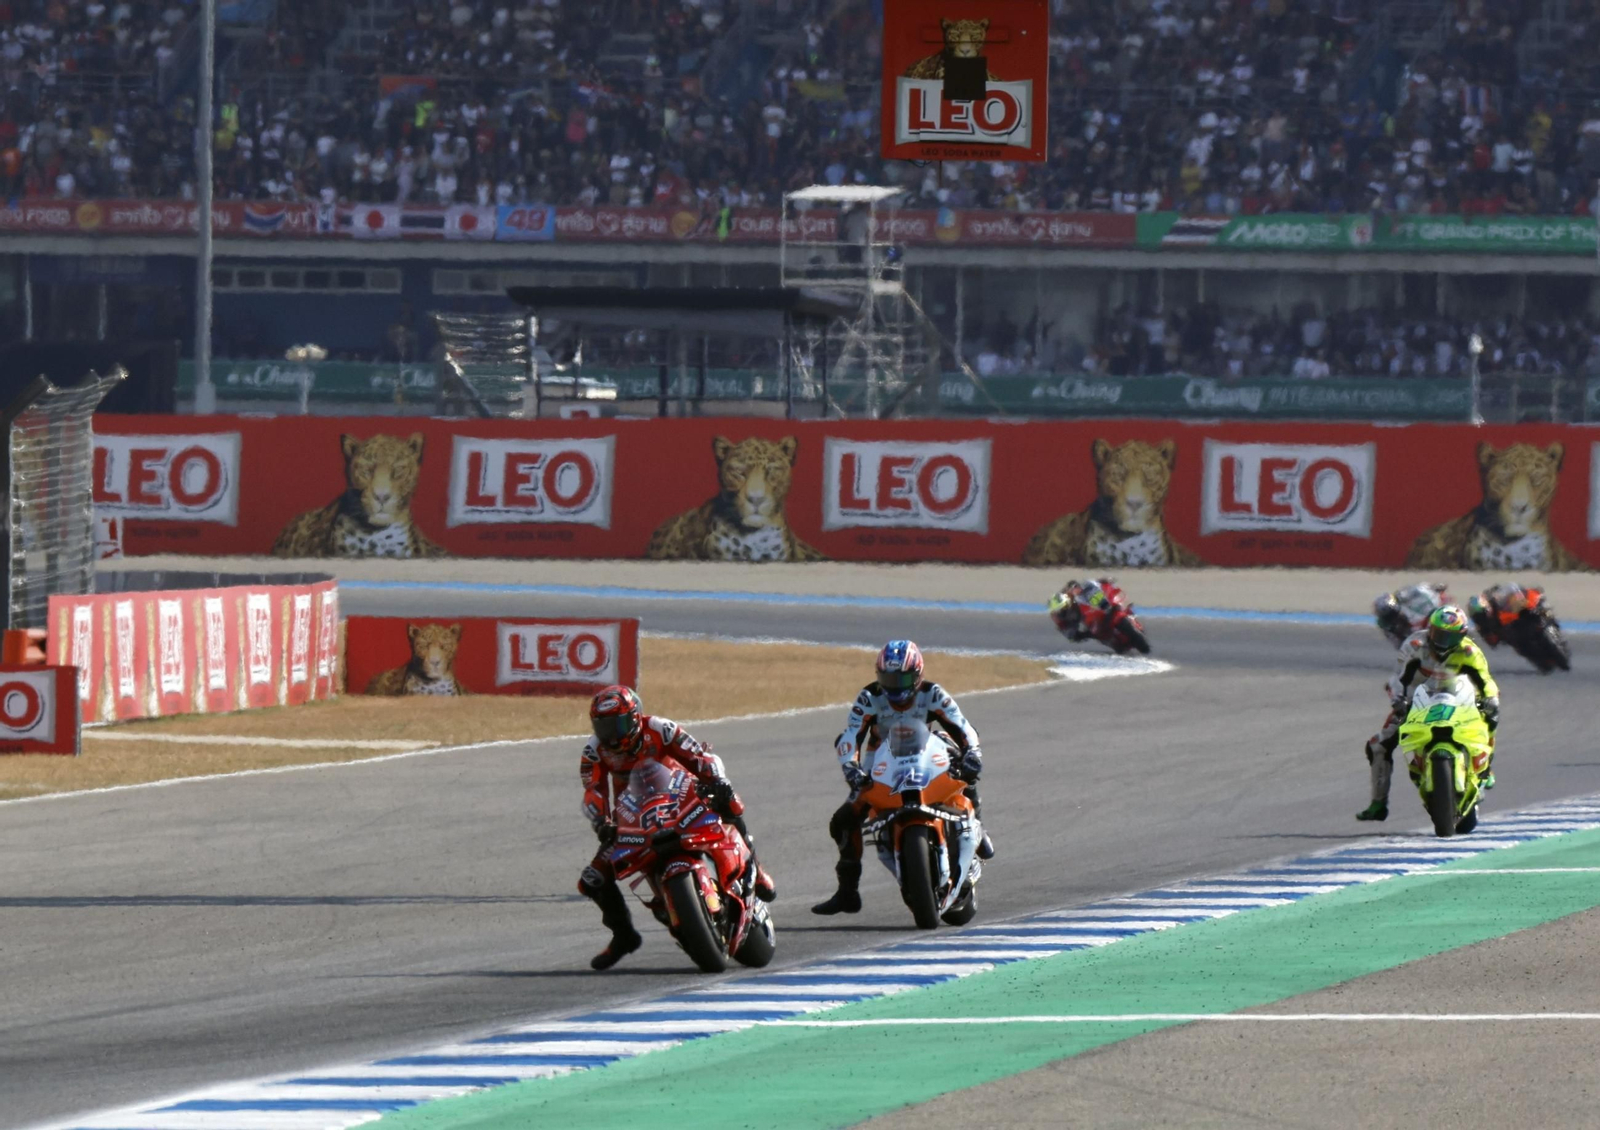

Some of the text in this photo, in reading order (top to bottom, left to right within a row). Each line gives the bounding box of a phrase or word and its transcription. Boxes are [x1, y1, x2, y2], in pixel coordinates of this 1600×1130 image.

[908, 88, 1022, 136] LEO
[1419, 222, 1485, 241] GRAND
[1487, 222, 1539, 241] PRIX
[1541, 223, 1566, 240] OF
[93, 445, 228, 512] LEO
[465, 449, 600, 514] LEO
[839, 452, 979, 520] LEO
[1218, 455, 1362, 525] LEO
[508, 632, 611, 677] LEO
[617, 835, 645, 844] Lenovo
[678, 805, 705, 829] Lenovo
